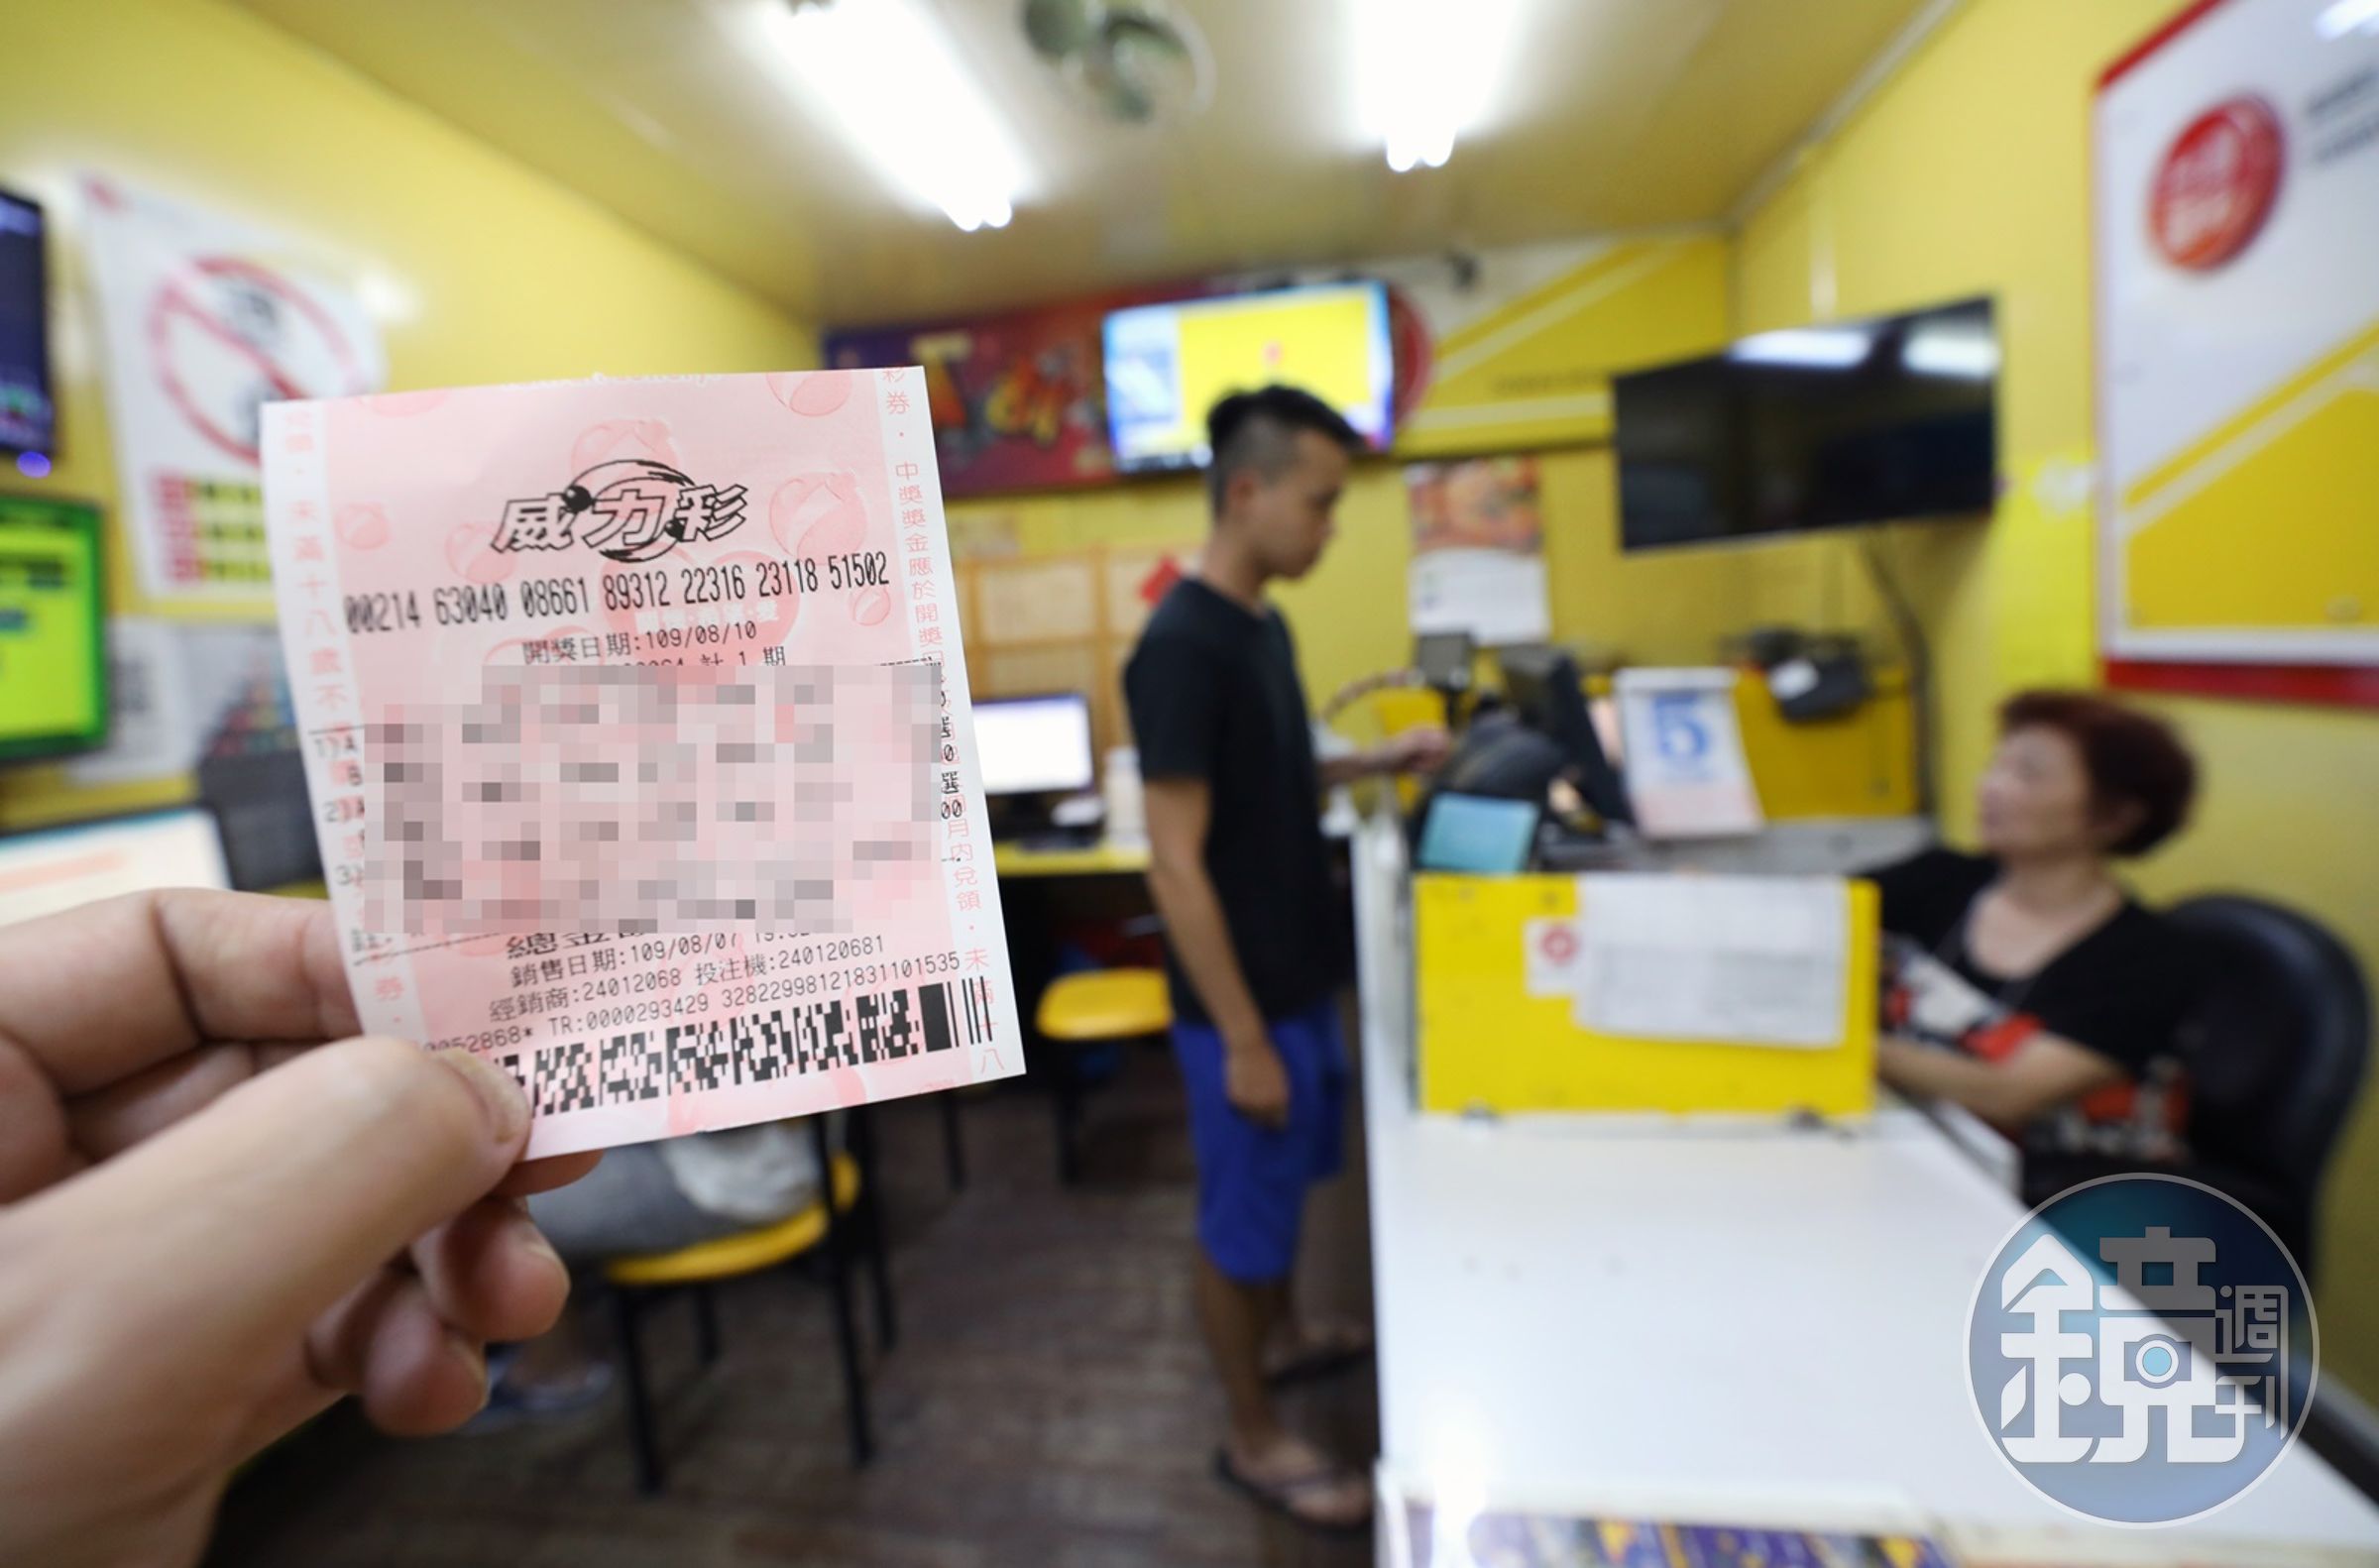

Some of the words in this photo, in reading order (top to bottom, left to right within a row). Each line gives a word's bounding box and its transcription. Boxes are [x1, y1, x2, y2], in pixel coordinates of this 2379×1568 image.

[491, 484, 748, 553] 威力彩
[344, 591, 421, 633] 00214
[433, 583, 508, 624] 63040
[520, 577, 590, 617] 08661
[603, 570, 670, 611] 89312
[681, 564, 745, 605] 22316
[755, 558, 819, 597] 23118
[829, 551, 890, 590] 51502
